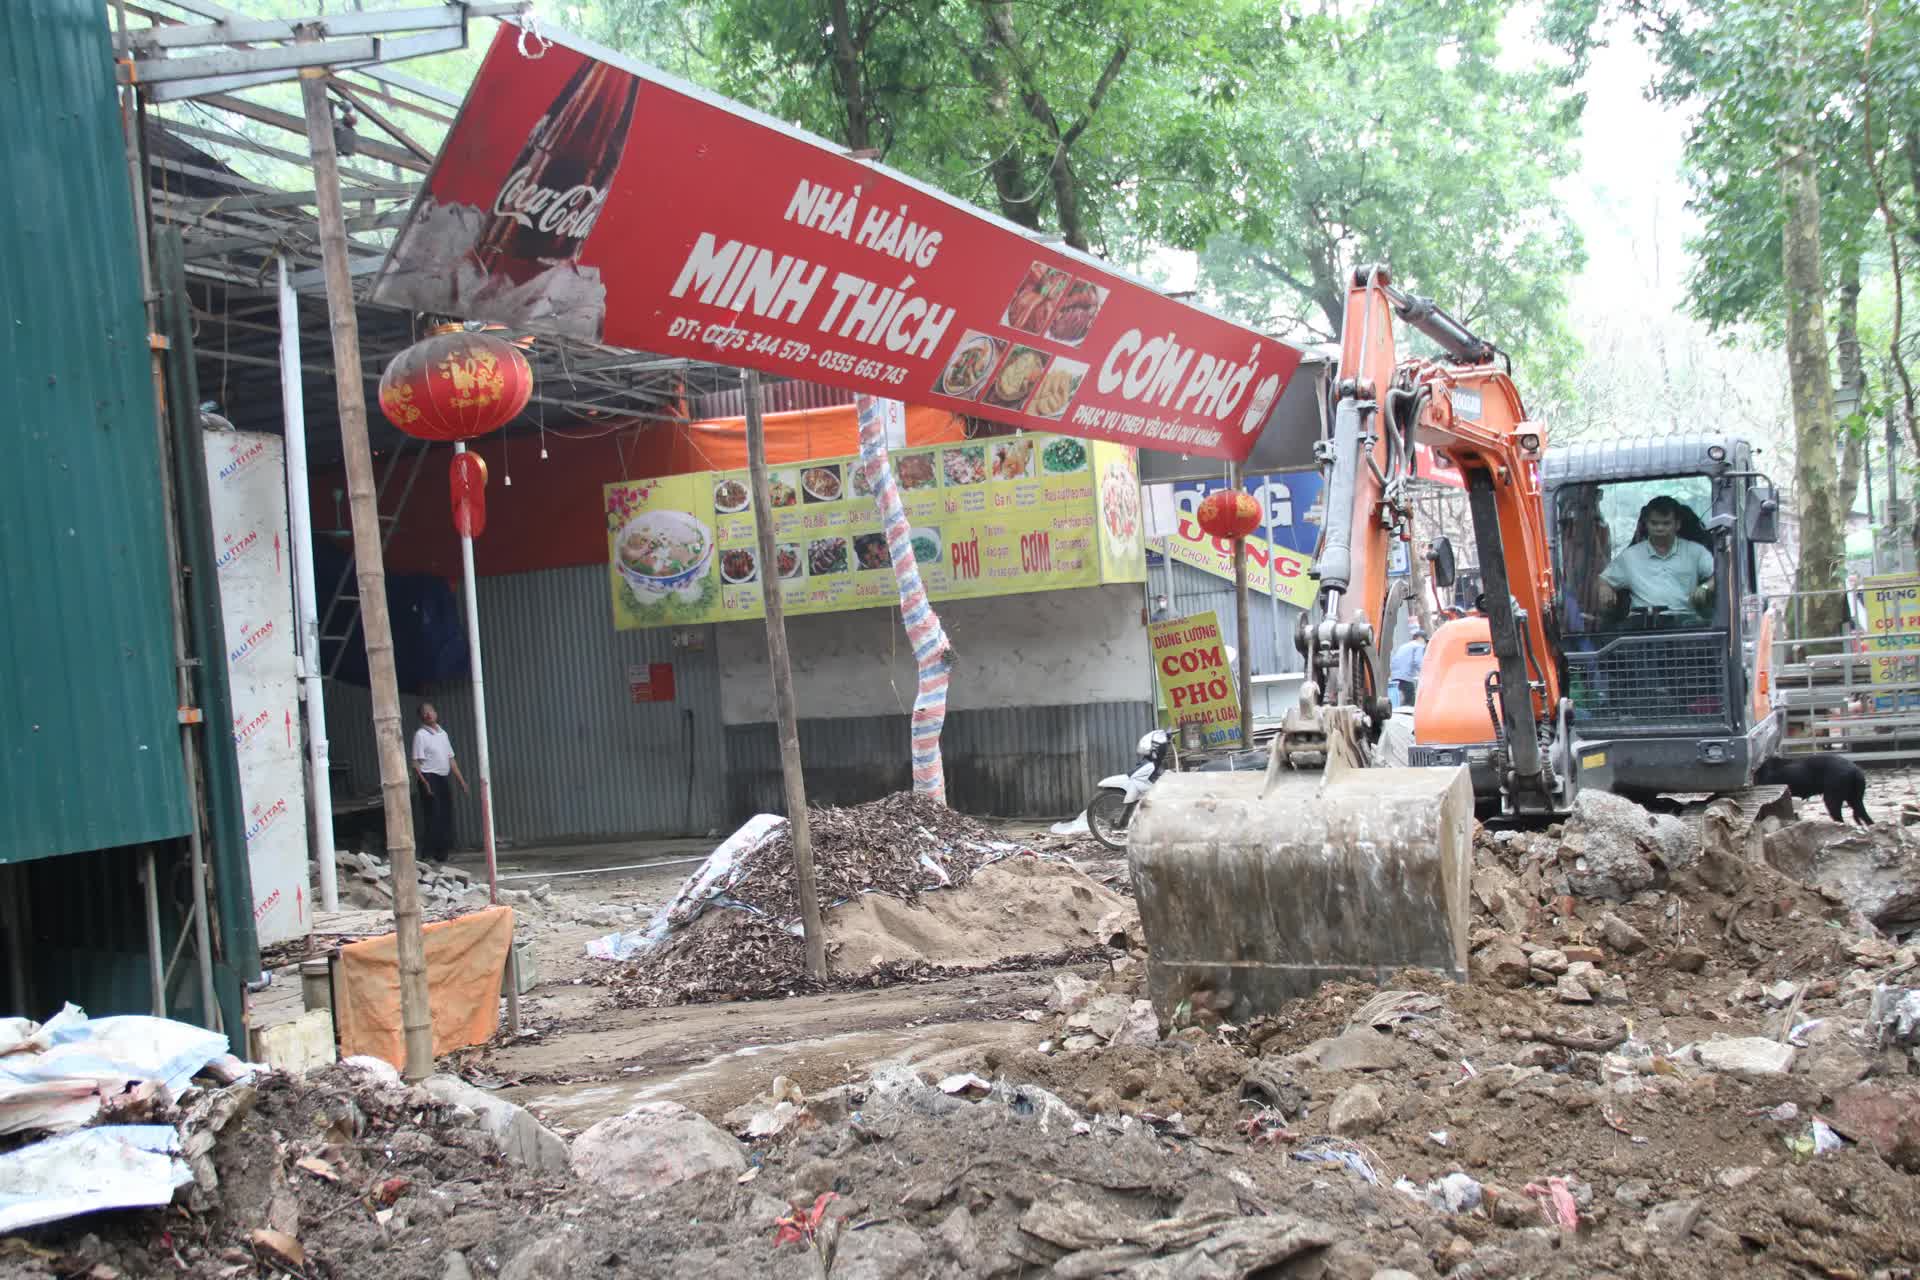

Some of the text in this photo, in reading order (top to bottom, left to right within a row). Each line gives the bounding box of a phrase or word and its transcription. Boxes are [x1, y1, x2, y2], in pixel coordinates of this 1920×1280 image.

[784, 178, 944, 268] NHÀ HÀNG
[669, 231, 956, 359] MINH THÍCH
[745, 332, 783, 357] 344
[777, 339, 810, 363] 579
[818, 349, 854, 374] 0355
[853, 358, 884, 380] 663
[881, 366, 908, 385] 743
[1097, 328, 1262, 421] CƠM PHỞ
[219, 442, 264, 480] ALUTITAN
[951, 527, 980, 580] PHỞ
[1020, 529, 1052, 574] CƠM
[231, 619, 273, 661] ALUTITAN
[1162, 646, 1223, 676] CƠM
[1169, 670, 1228, 709] PHỞ
[253, 889, 280, 918] TITAN
